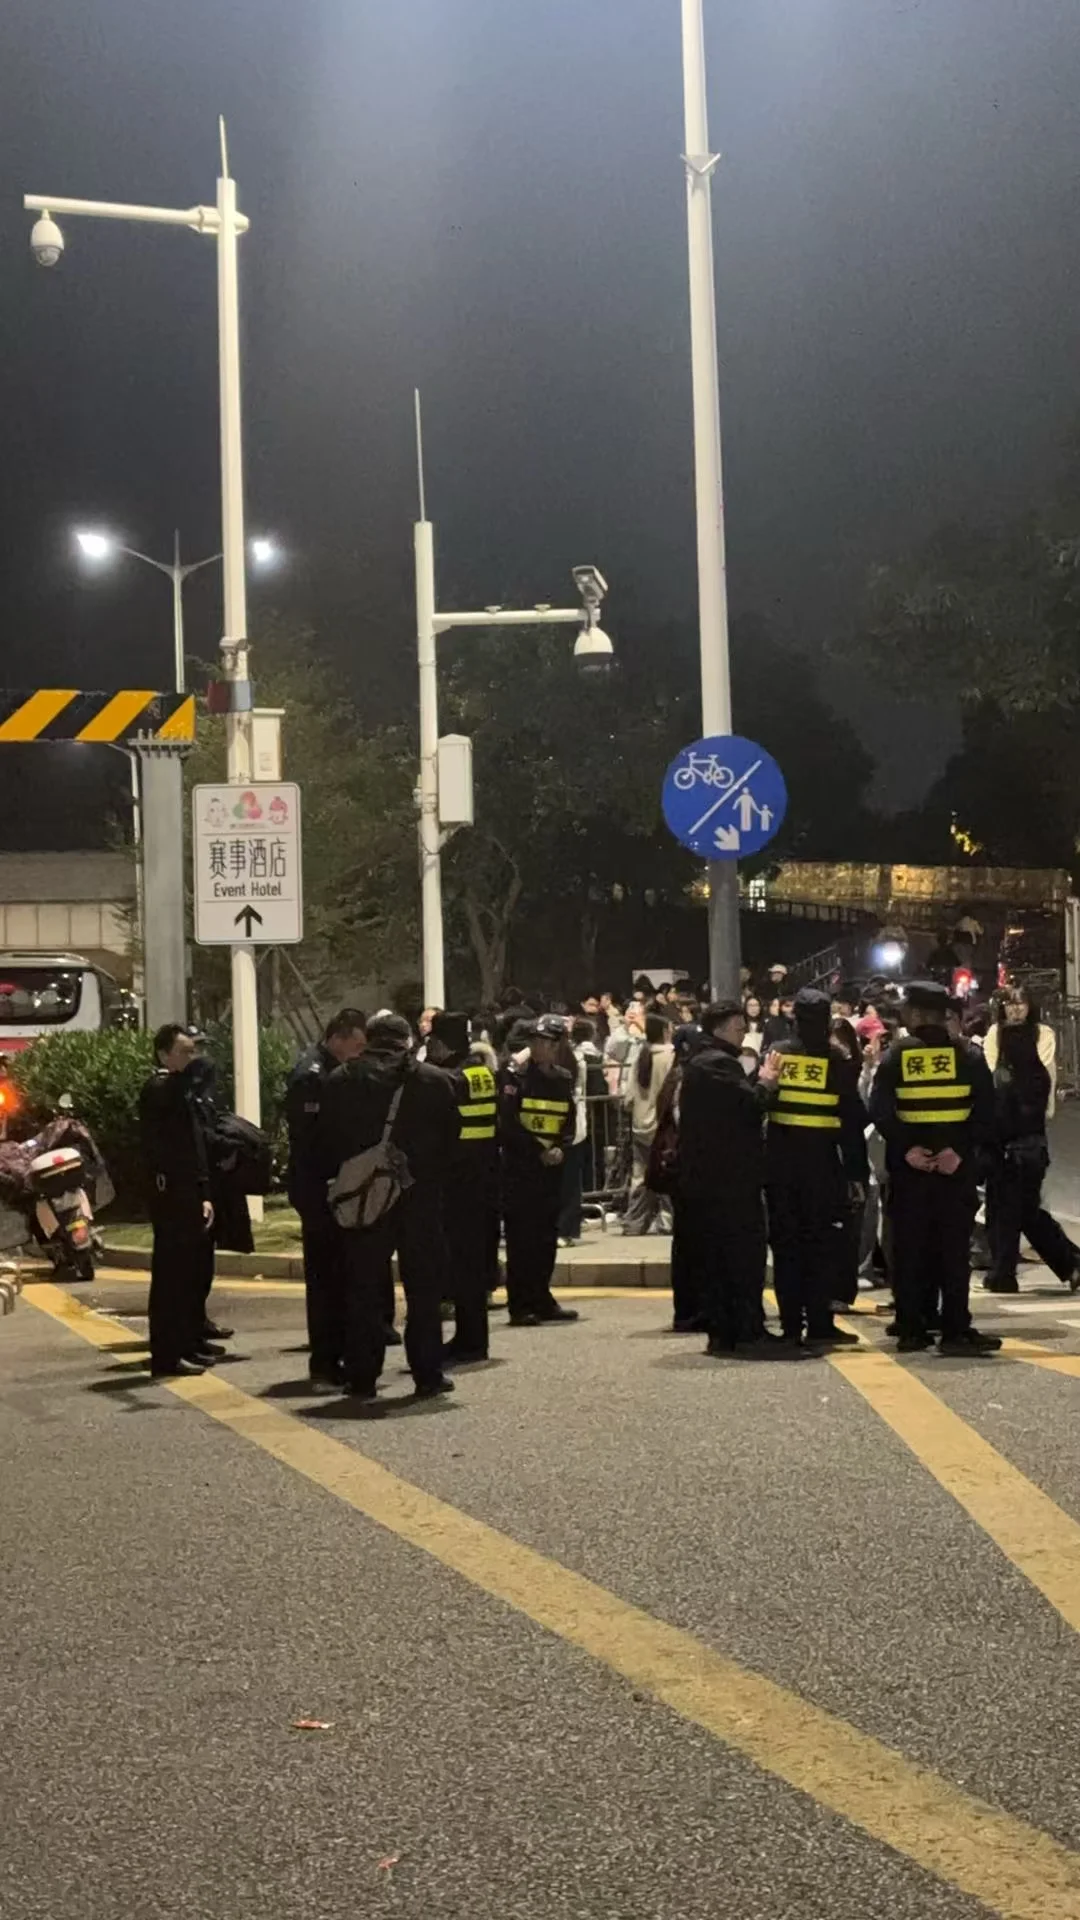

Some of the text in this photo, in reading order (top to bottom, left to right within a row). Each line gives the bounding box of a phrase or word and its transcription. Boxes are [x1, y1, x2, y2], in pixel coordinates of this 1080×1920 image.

[209, 837, 287, 879] 赛事酒店
[214, 881, 282, 897] Event Hotel
[781, 1061, 823, 1083] 保安
[906, 1054, 951, 1075] 保安
